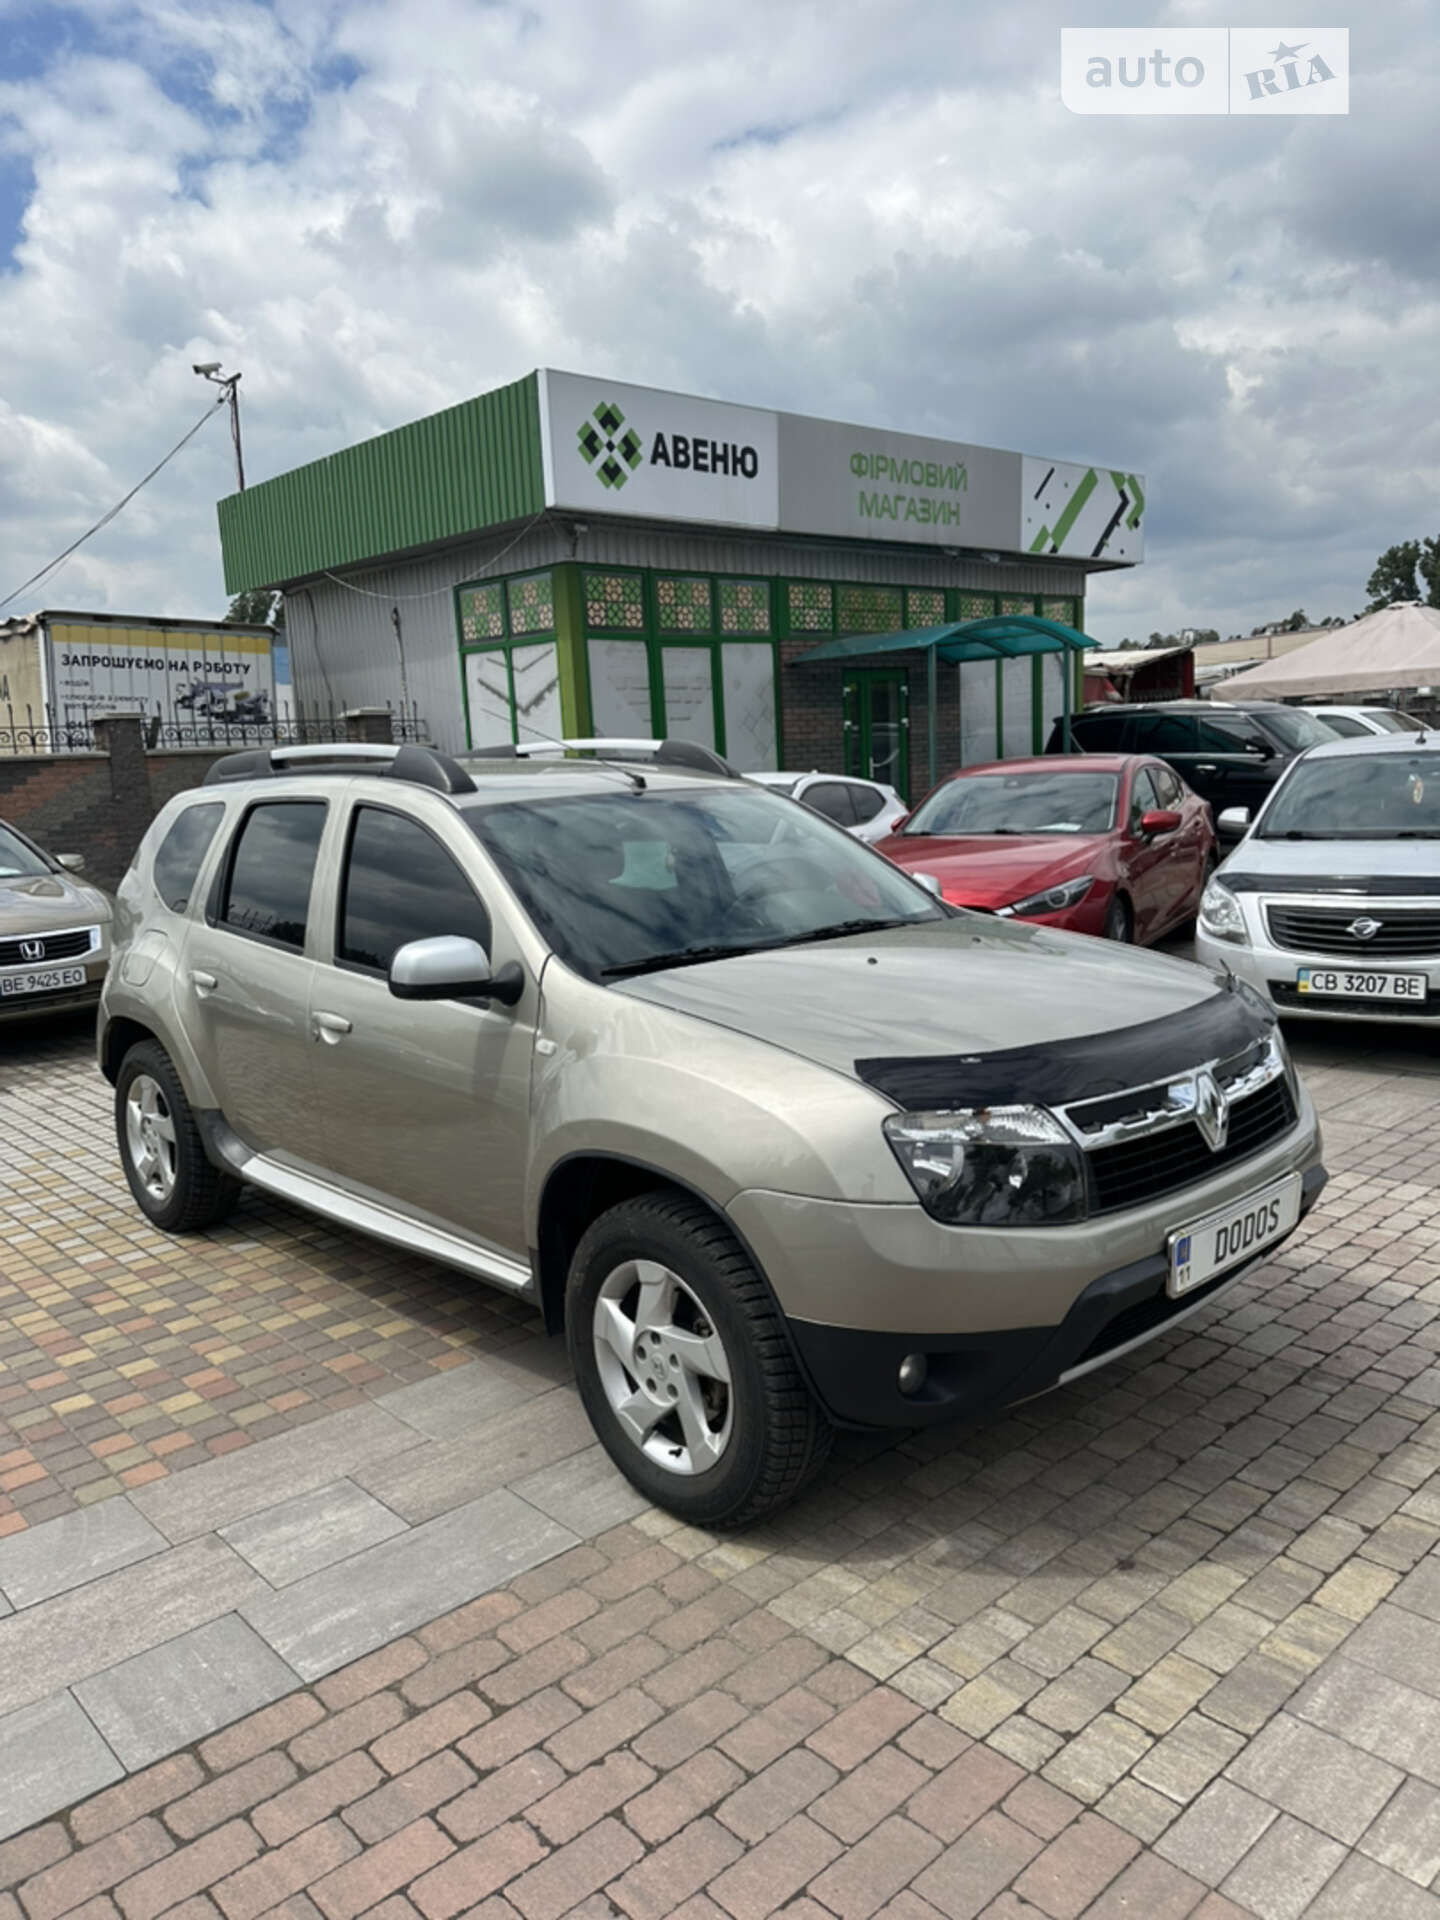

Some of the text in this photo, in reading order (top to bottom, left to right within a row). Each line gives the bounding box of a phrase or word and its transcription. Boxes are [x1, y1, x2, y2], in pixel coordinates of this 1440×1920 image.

[650, 431, 759, 480] АВЕНЮ
[850, 451, 969, 493] ФІРМОВИЙ
[858, 490, 961, 527] МАГАЗИН
[61, 653, 251, 675] ЗАПРОШУЄМО НА РОБОТУ
[2, 977, 25, 993] BE
[62, 969, 83, 984] EO
[1311, 972, 1420, 996] CB 3207 BE
